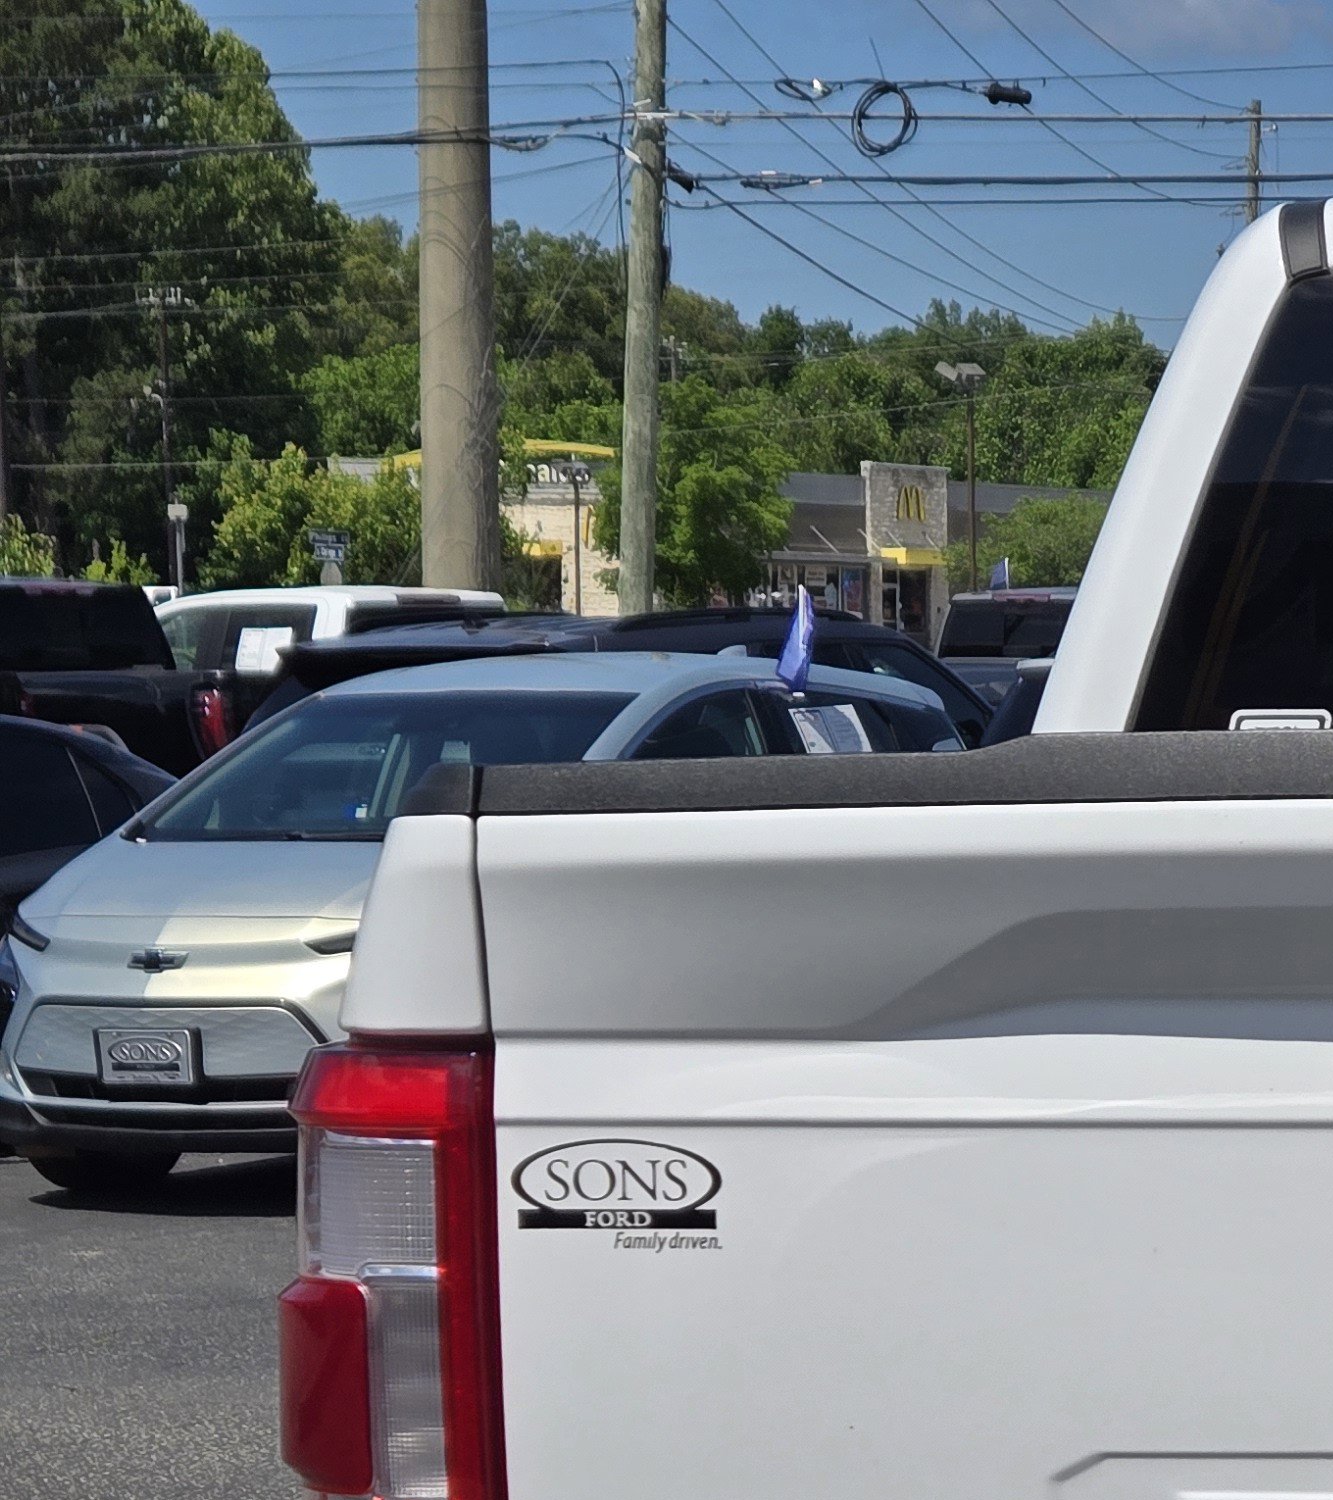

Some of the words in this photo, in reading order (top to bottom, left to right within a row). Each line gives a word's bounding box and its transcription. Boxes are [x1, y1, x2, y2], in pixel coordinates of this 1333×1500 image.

[118, 1042, 172, 1061] SONS
[544, 1158, 688, 1202] SONS
[583, 1210, 653, 1228] FORD
[613, 1231, 669, 1254] Family
